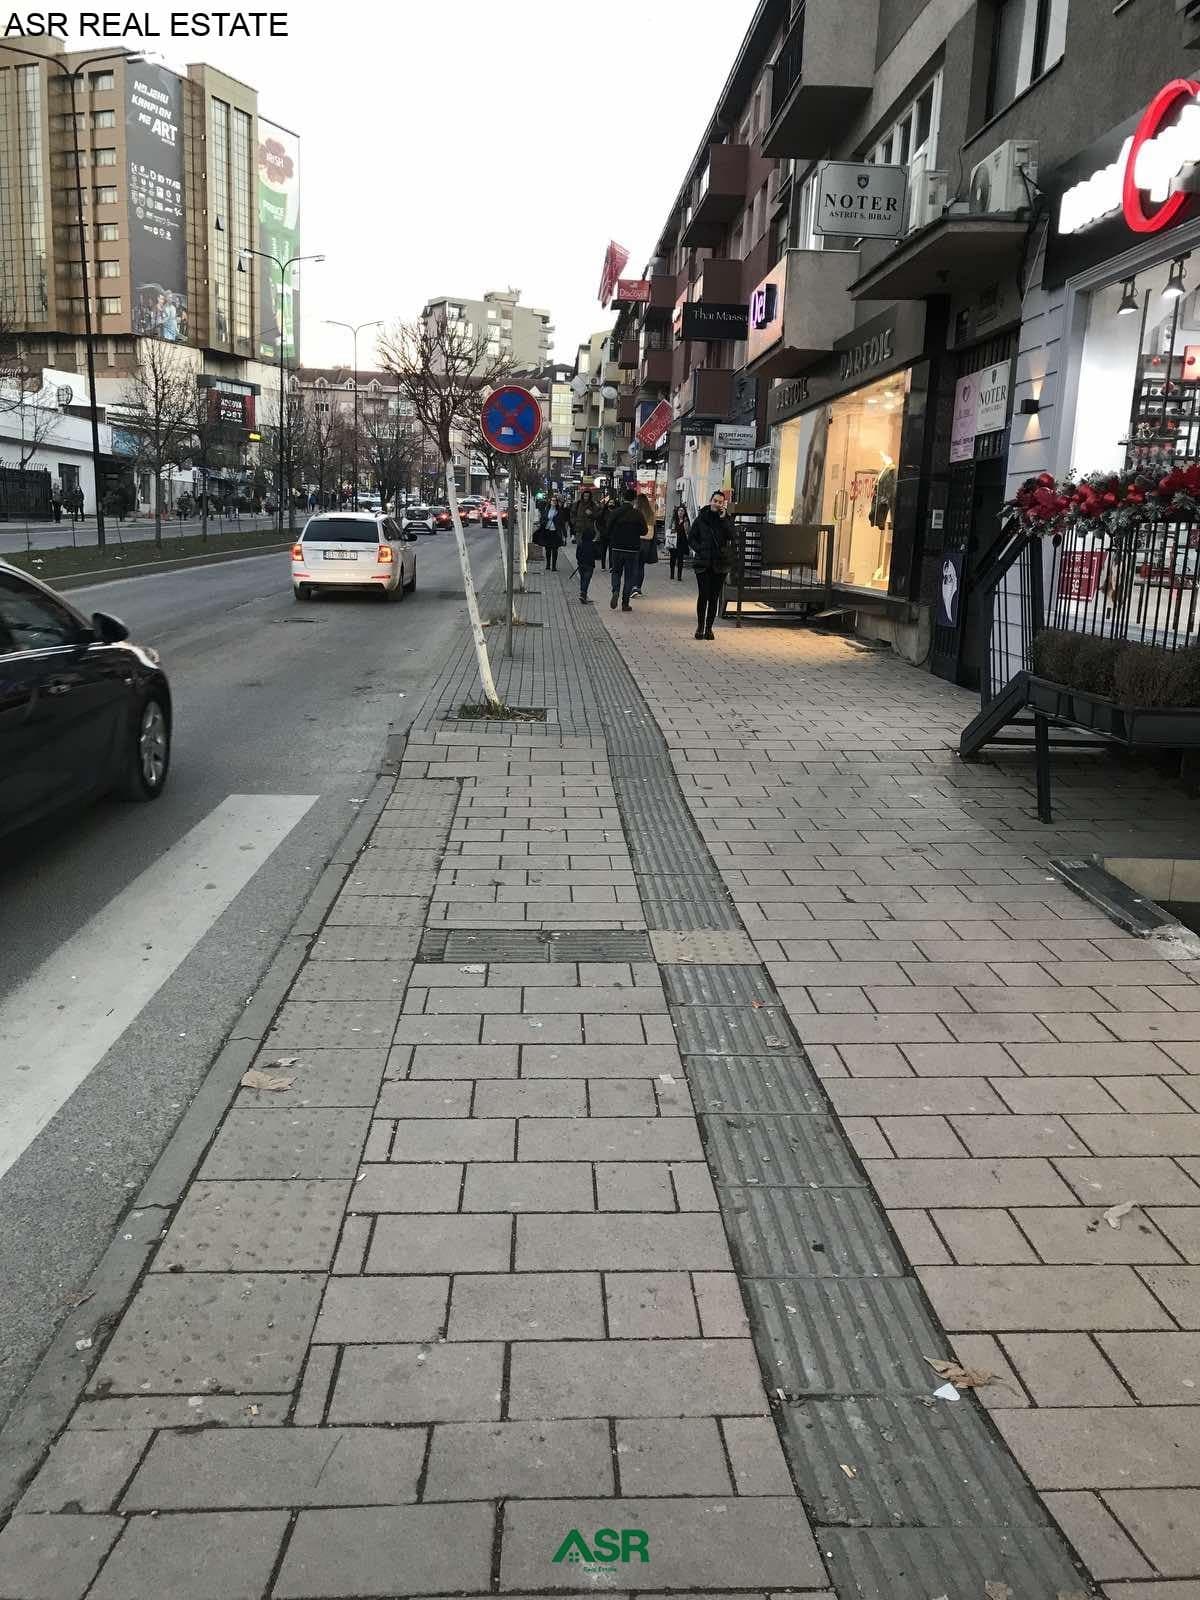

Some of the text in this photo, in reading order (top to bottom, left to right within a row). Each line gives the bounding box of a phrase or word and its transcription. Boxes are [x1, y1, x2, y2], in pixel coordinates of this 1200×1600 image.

[131, 94, 172, 120] KAMPION
[138, 112, 178, 141] ME ART
[824, 193, 897, 212] NOTER
[829, 210, 857, 219] ASTRIT
[979, 383, 1007, 408] NOTER
